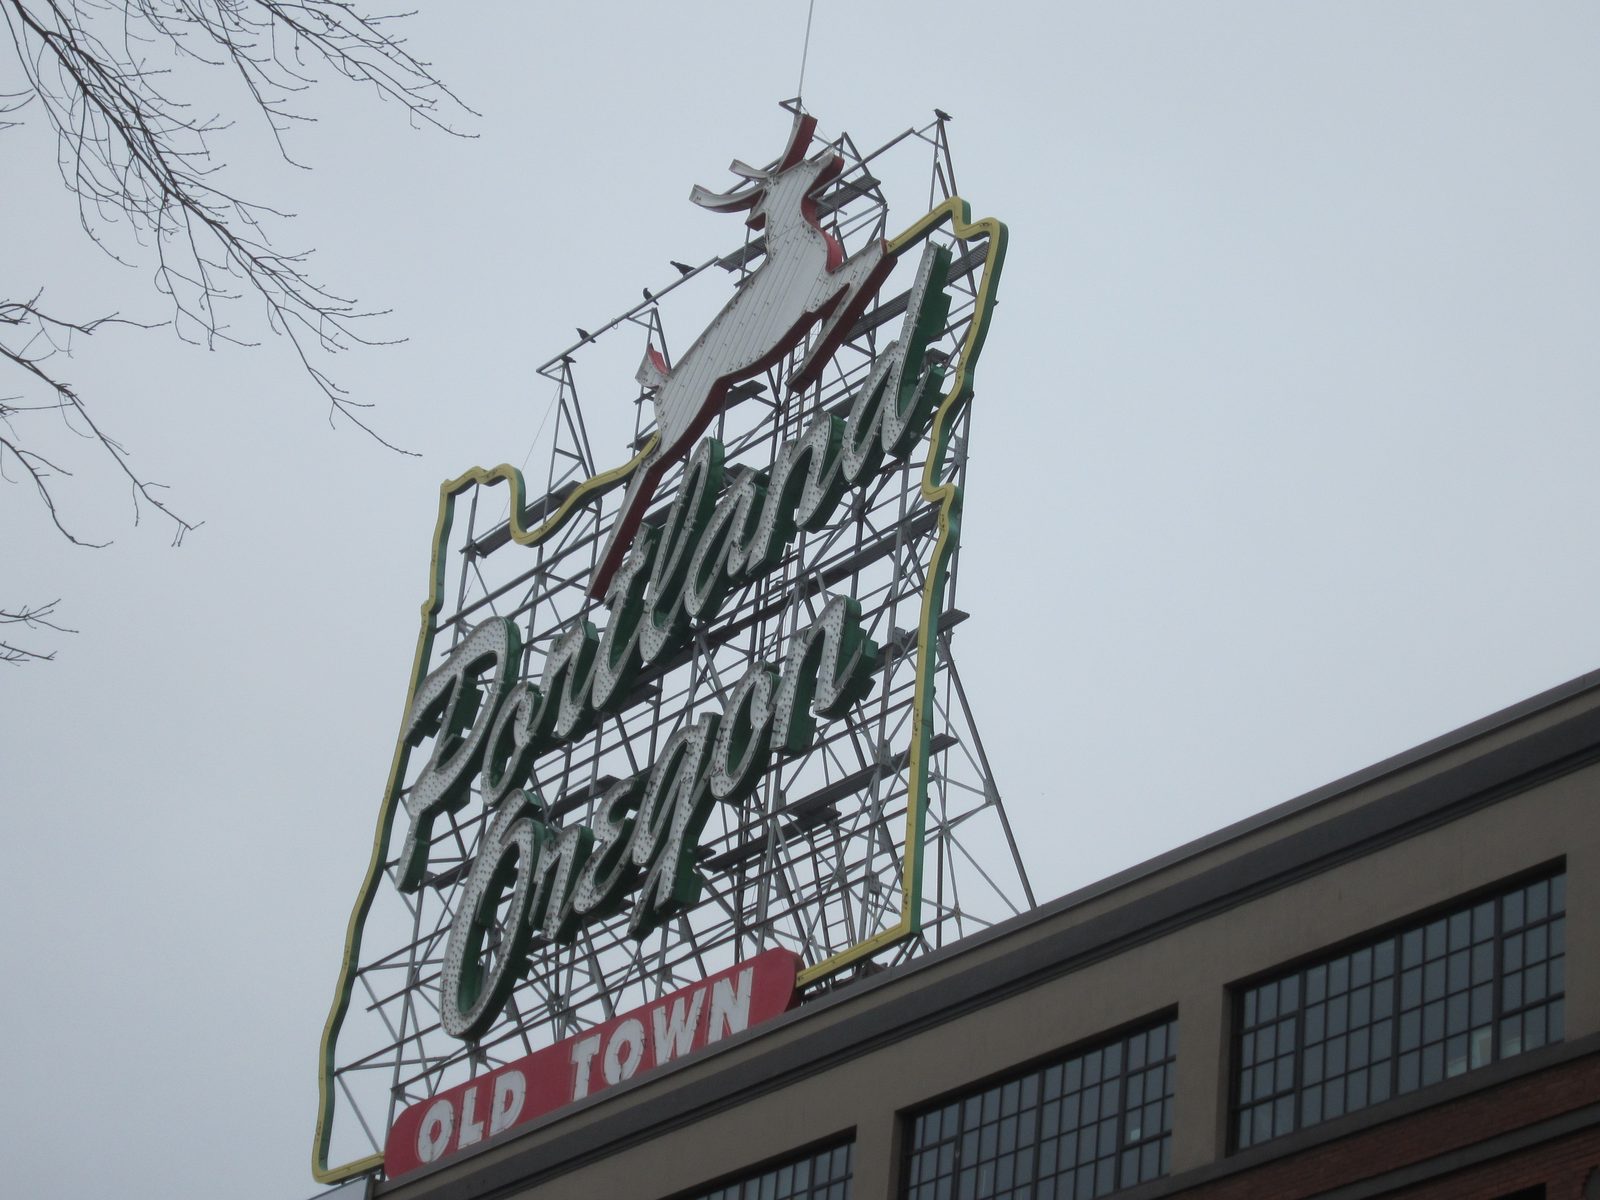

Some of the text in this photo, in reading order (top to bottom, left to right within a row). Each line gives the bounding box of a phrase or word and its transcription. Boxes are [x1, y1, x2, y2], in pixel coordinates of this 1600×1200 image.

[402, 241, 953, 893] Portland
[440, 594, 879, 1040] Oregon
[417, 966, 754, 1163] OLD TOWN
